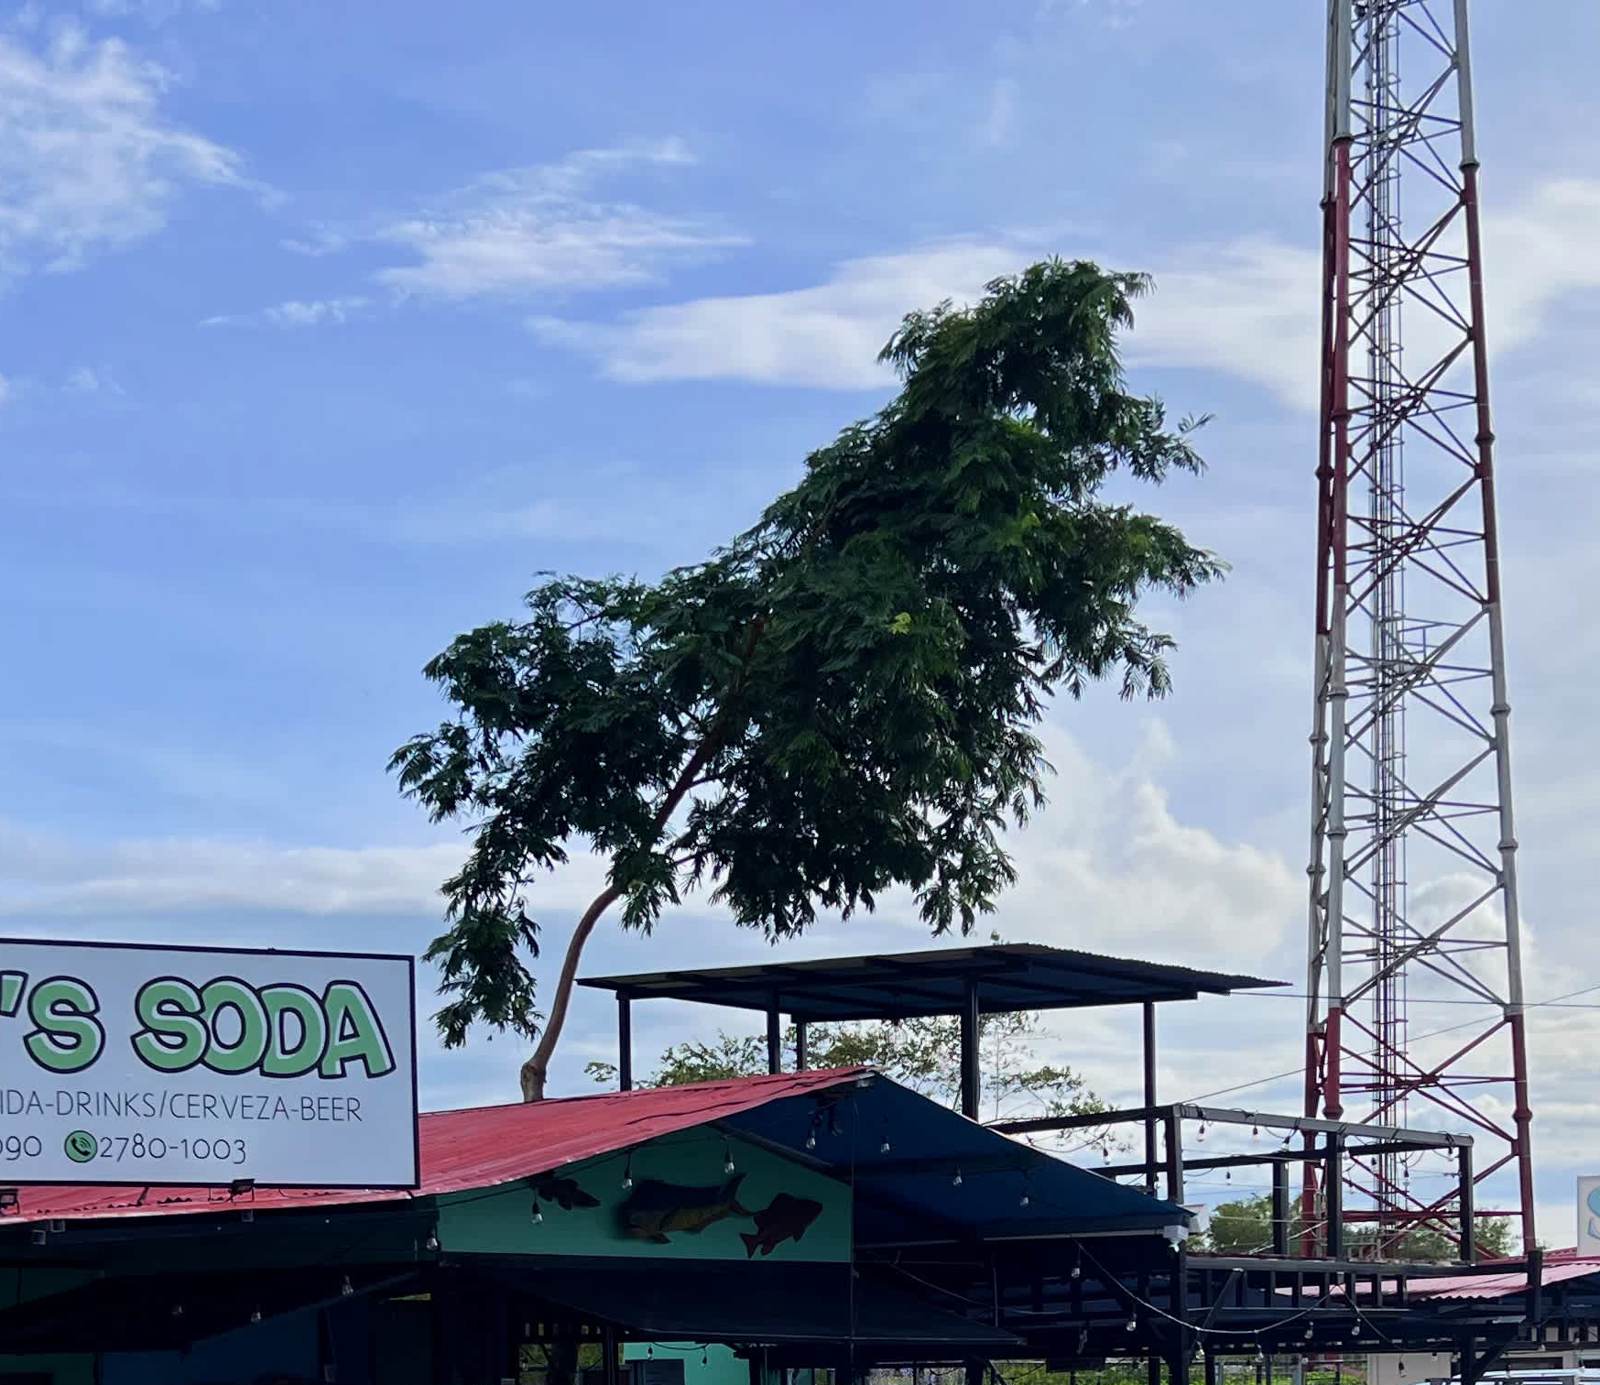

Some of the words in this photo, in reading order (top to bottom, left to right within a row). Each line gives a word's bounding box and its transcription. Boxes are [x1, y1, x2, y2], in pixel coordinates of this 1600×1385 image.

[131, 975, 396, 1079] SODA
[0, 1089, 363, 1122] IDA-DRINKS/CERVEZA-BEER
[0, 1136, 42, 1161] 90
[99, 1132, 247, 1165] 2780-1003
